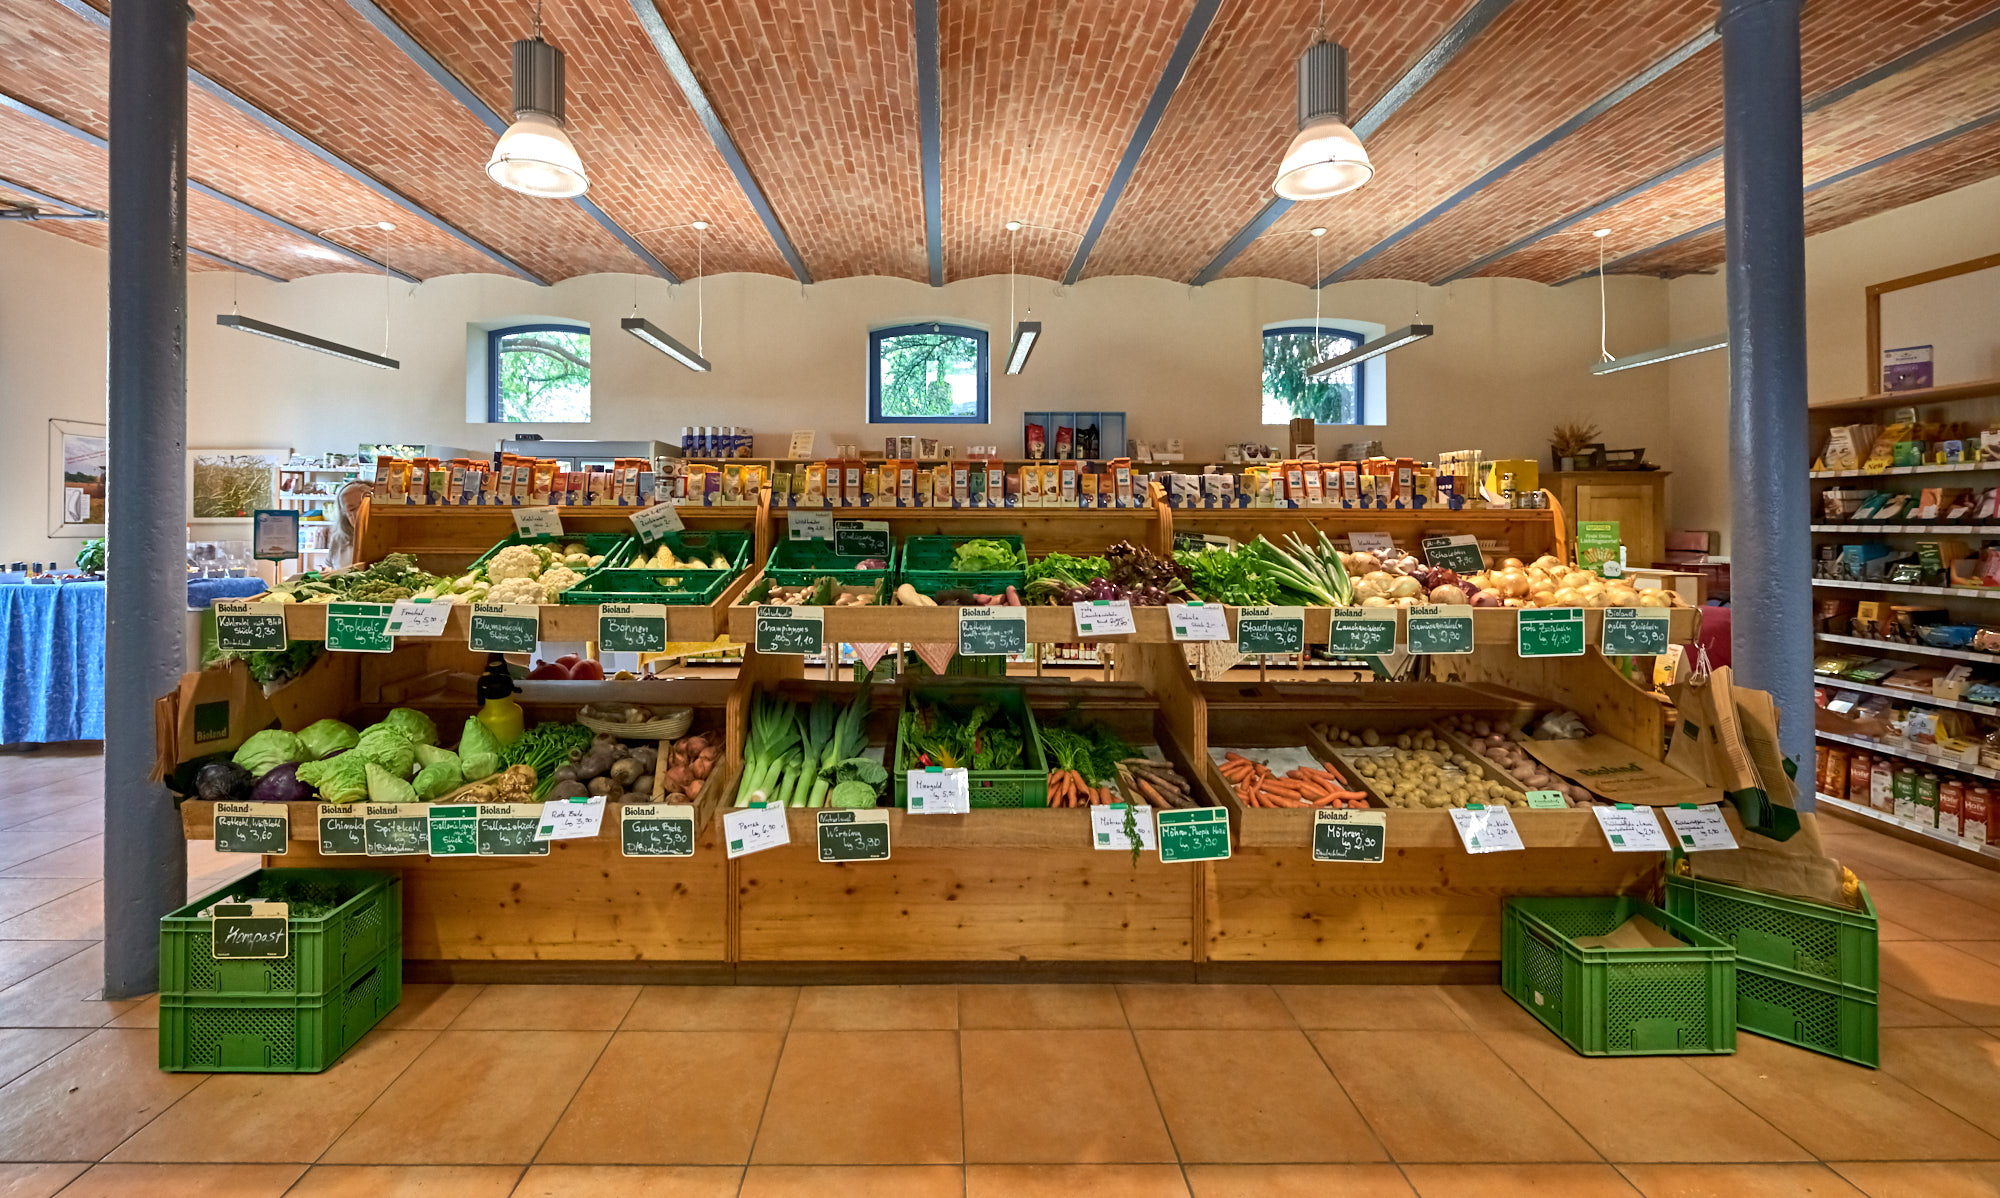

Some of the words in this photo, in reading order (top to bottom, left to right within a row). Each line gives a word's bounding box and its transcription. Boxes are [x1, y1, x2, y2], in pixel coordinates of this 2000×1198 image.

[218, 603, 248, 613] Bioland
[474, 603, 504, 613] Bioland
[602, 605, 631, 614] Bioland
[962, 607, 991, 617] Bioland
[1241, 607, 1270, 616] Bioland
[1334, 608, 1363, 617] Bioland
[1410, 606, 1438, 616] Bioland
[607, 618, 649, 633] Bohnen
[255, 626, 277, 639] 2,30
[330, 636, 340, 646] D
[605, 639, 613, 647] D
[794, 633, 814, 647] 1,10
[1273, 632, 1298, 646] 3,60
[1638, 631, 1665, 646] 3,90
[964, 642, 973, 650] D
[1522, 642, 1531, 651] D
[196, 728, 228, 741] Bioland
[1576, 762, 1645, 777] Bioland
[217, 803, 249, 813] Bioland
[321, 805, 353, 815] Bioland
[366, 805, 398, 815] Bioland
[480, 805, 511, 815] Bioland
[624, 806, 656, 816] Bioland
[1318, 810, 1348, 820] Bioland
[373, 820, 422, 838] Spitzkohl
[1327, 824, 1361, 839] Möhren
[249, 829, 273, 843] 3,60
[662, 832, 688, 847] 3,90
[220, 840, 229, 848] D
[323, 840, 333, 849] D
[447, 844, 456, 852] D
[855, 837, 881, 852] 3,90
[1192, 839, 1218, 852] 3,90
[1354, 837, 1376, 851] 2,90
[1165, 848, 1175, 857] D
